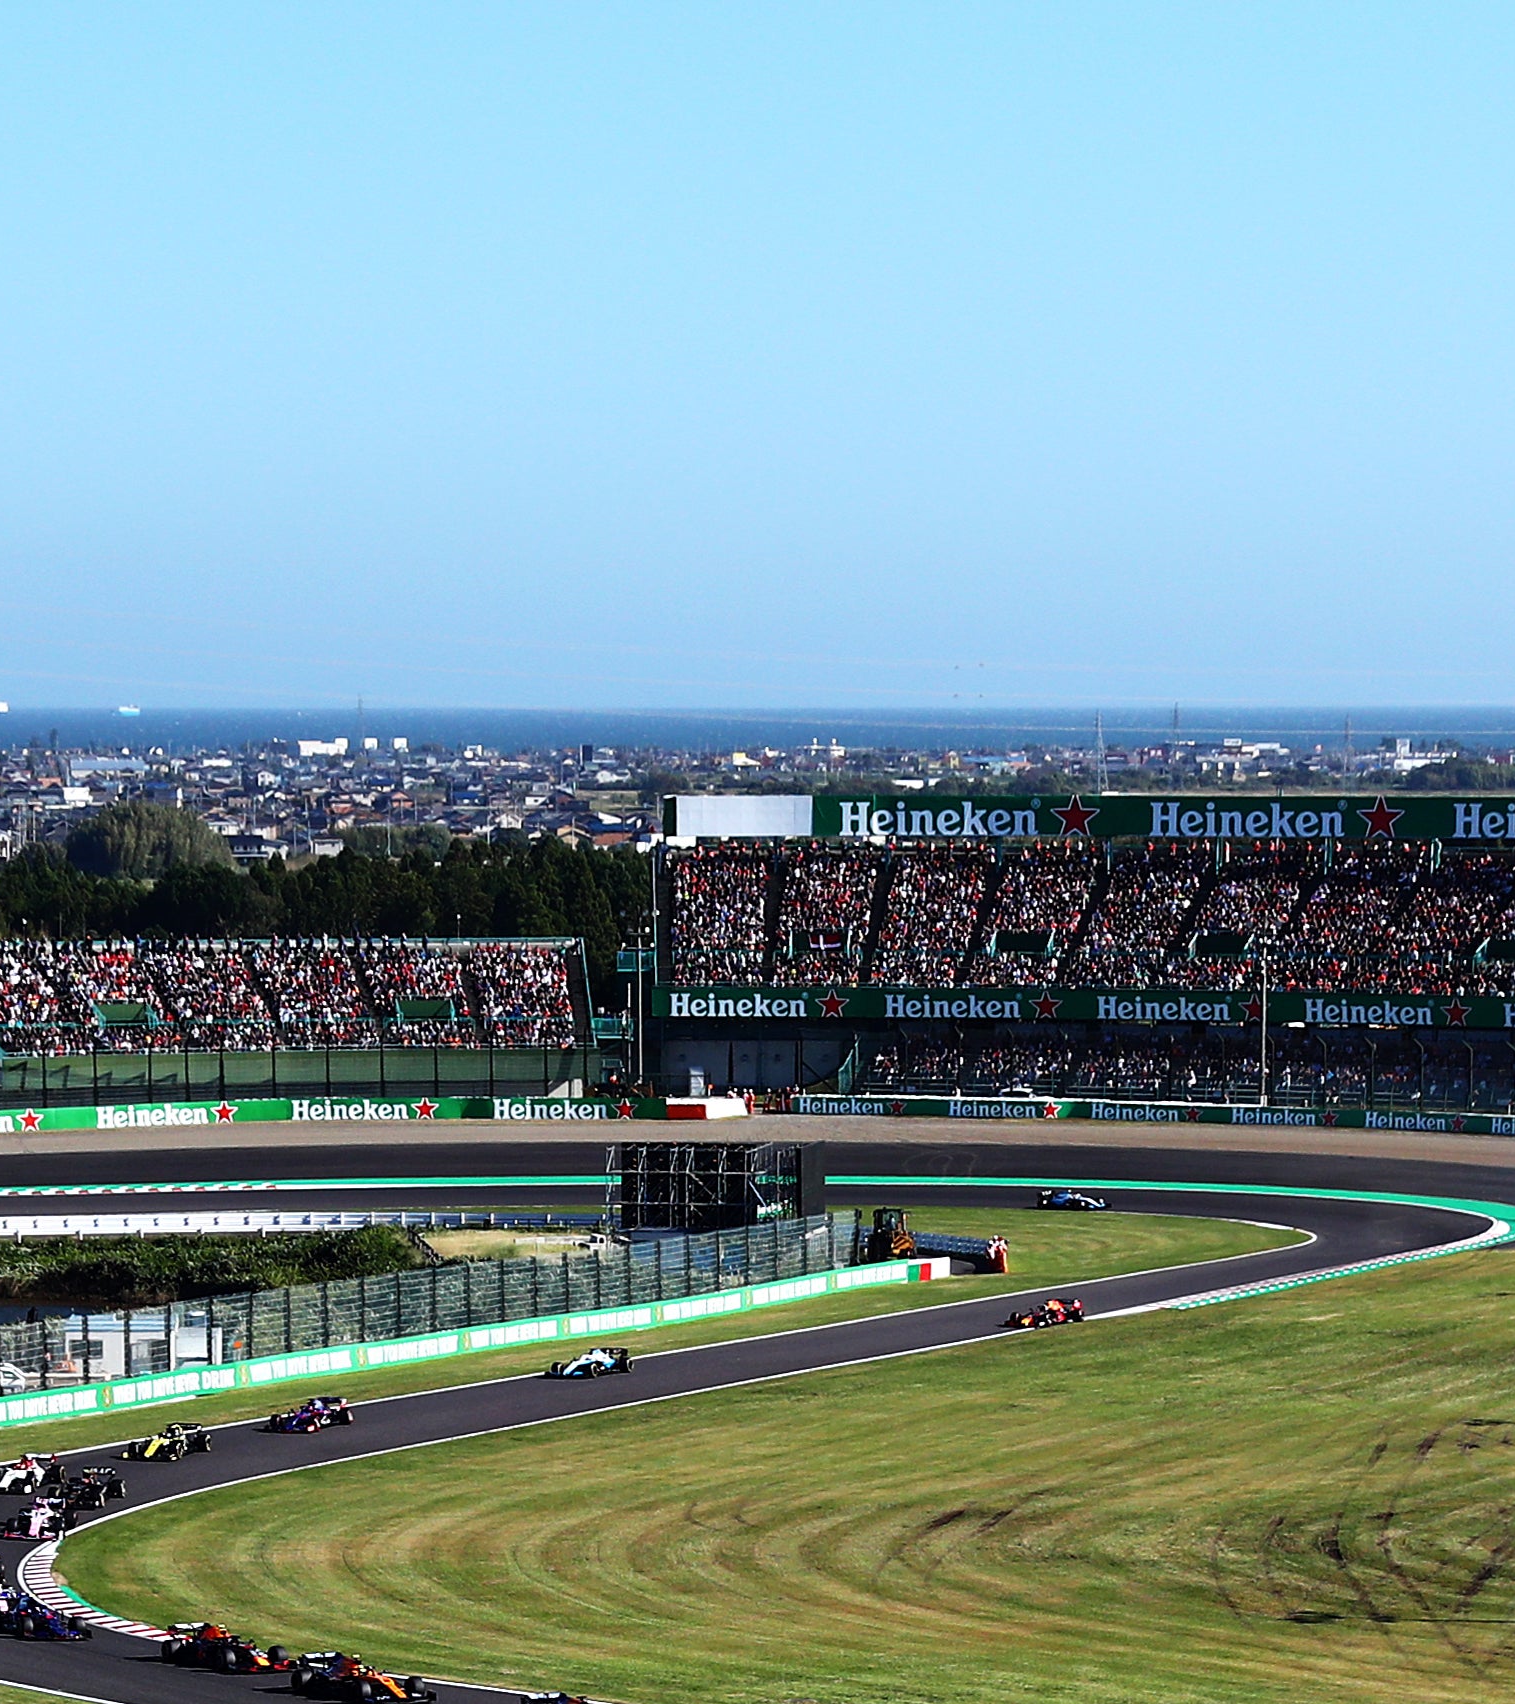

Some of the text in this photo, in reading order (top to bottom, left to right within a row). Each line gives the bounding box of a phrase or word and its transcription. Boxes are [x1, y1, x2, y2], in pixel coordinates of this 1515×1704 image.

[839, 801, 1038, 836] Heineken
[1150, 802, 1345, 837] Heineken
[669, 993, 807, 1018] Heineken
[885, 995, 1020, 1019] Heineken
[1096, 996, 1231, 1021] Heineken
[1304, 998, 1433, 1026] Heineken
[96, 1102, 209, 1128] Heineken
[292, 1099, 409, 1121] Heineken
[493, 1099, 608, 1120] Heineken
[798, 1097, 884, 1115] Heineken
[948, 1101, 1036, 1119] Heineken
[1090, 1102, 1179, 1122] Heineken
[1230, 1106, 1316, 1127] Heineken
[1364, 1110, 1447, 1132] Heineken
